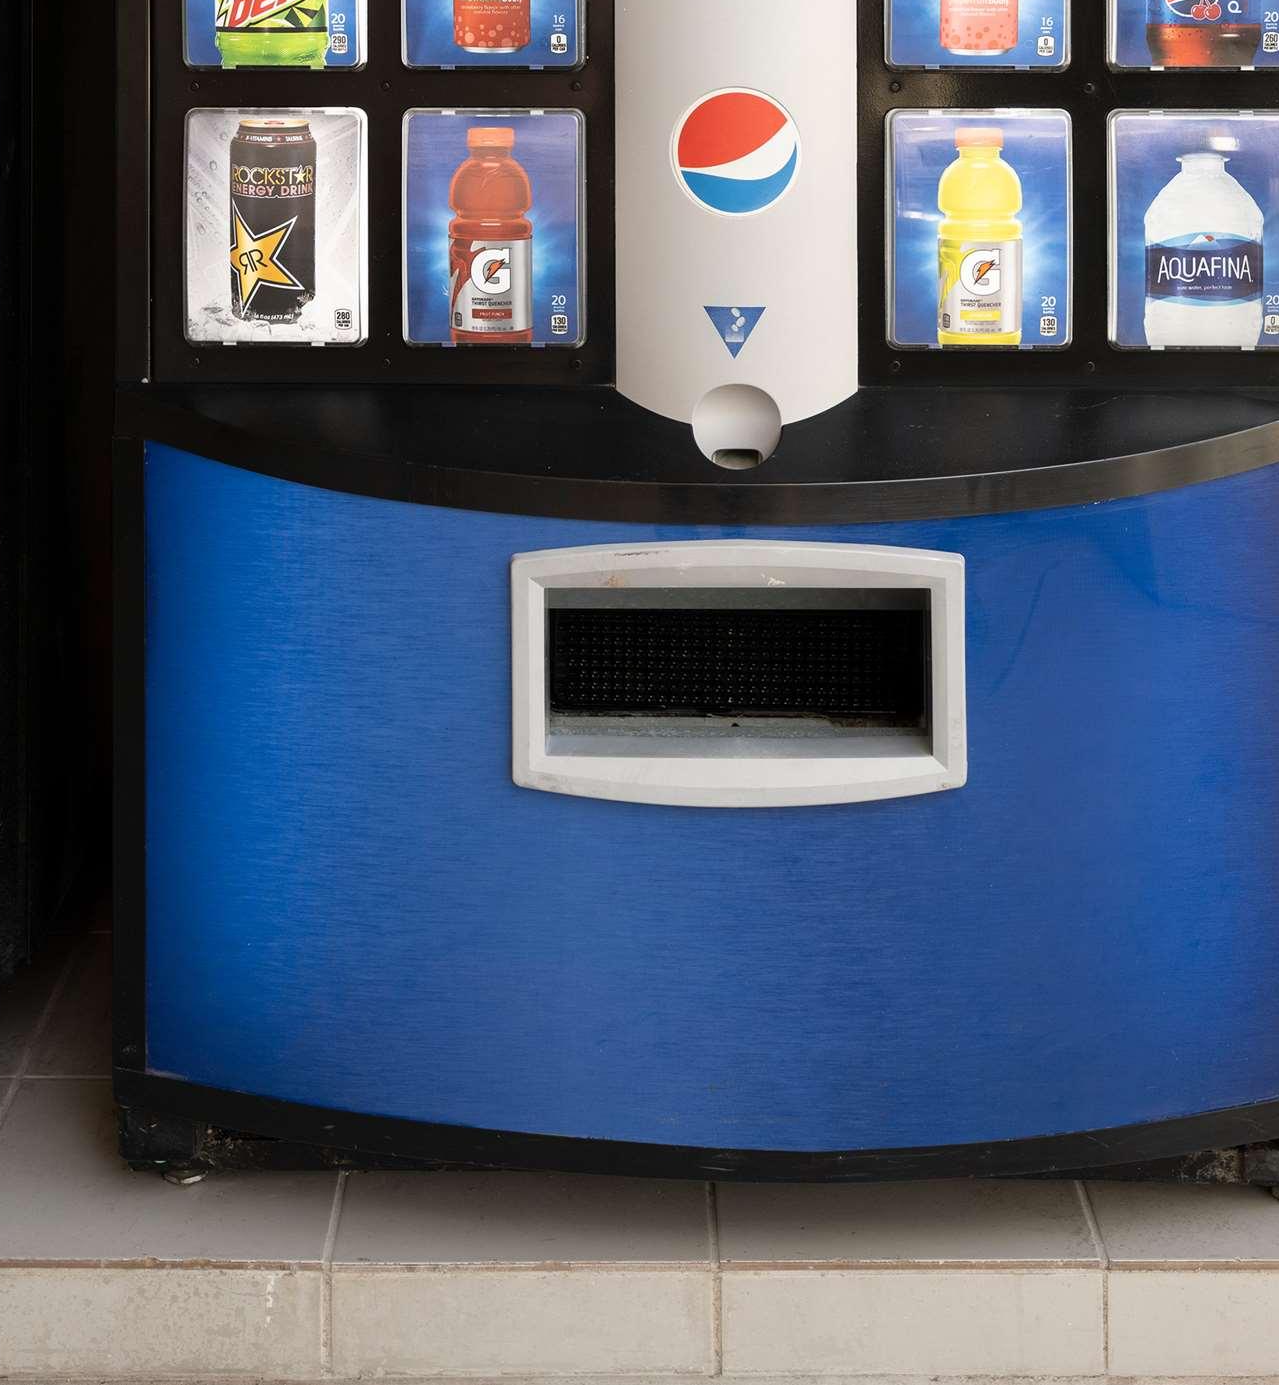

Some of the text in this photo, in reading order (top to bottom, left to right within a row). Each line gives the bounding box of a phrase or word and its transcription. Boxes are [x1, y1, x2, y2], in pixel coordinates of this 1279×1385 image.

[331, 13, 346, 24] 20
[553, 14, 566, 24] 16
[1040, 16, 1054, 27] 16
[1263, 11, 1279, 22] 20
[333, 35, 346, 44] 290
[556, 35, 561, 43] 0
[1043, 38, 1048, 46] 0
[1265, 33, 1278, 43] 260
[232, 183, 313, 196] ENERGY DRINK
[470, 247, 511, 294] G
[960, 248, 1001, 294] G
[1157, 254, 1252, 284] AQUAFINA
[551, 295, 566, 306] 20
[1041, 296, 1056, 307] 20
[1265, 295, 1279, 305] 20
[336, 311, 350, 320] 280
[1270, 316, 1275, 325] 0
[553, 317, 565, 325] 130
[1042, 318, 1055, 326] 130
